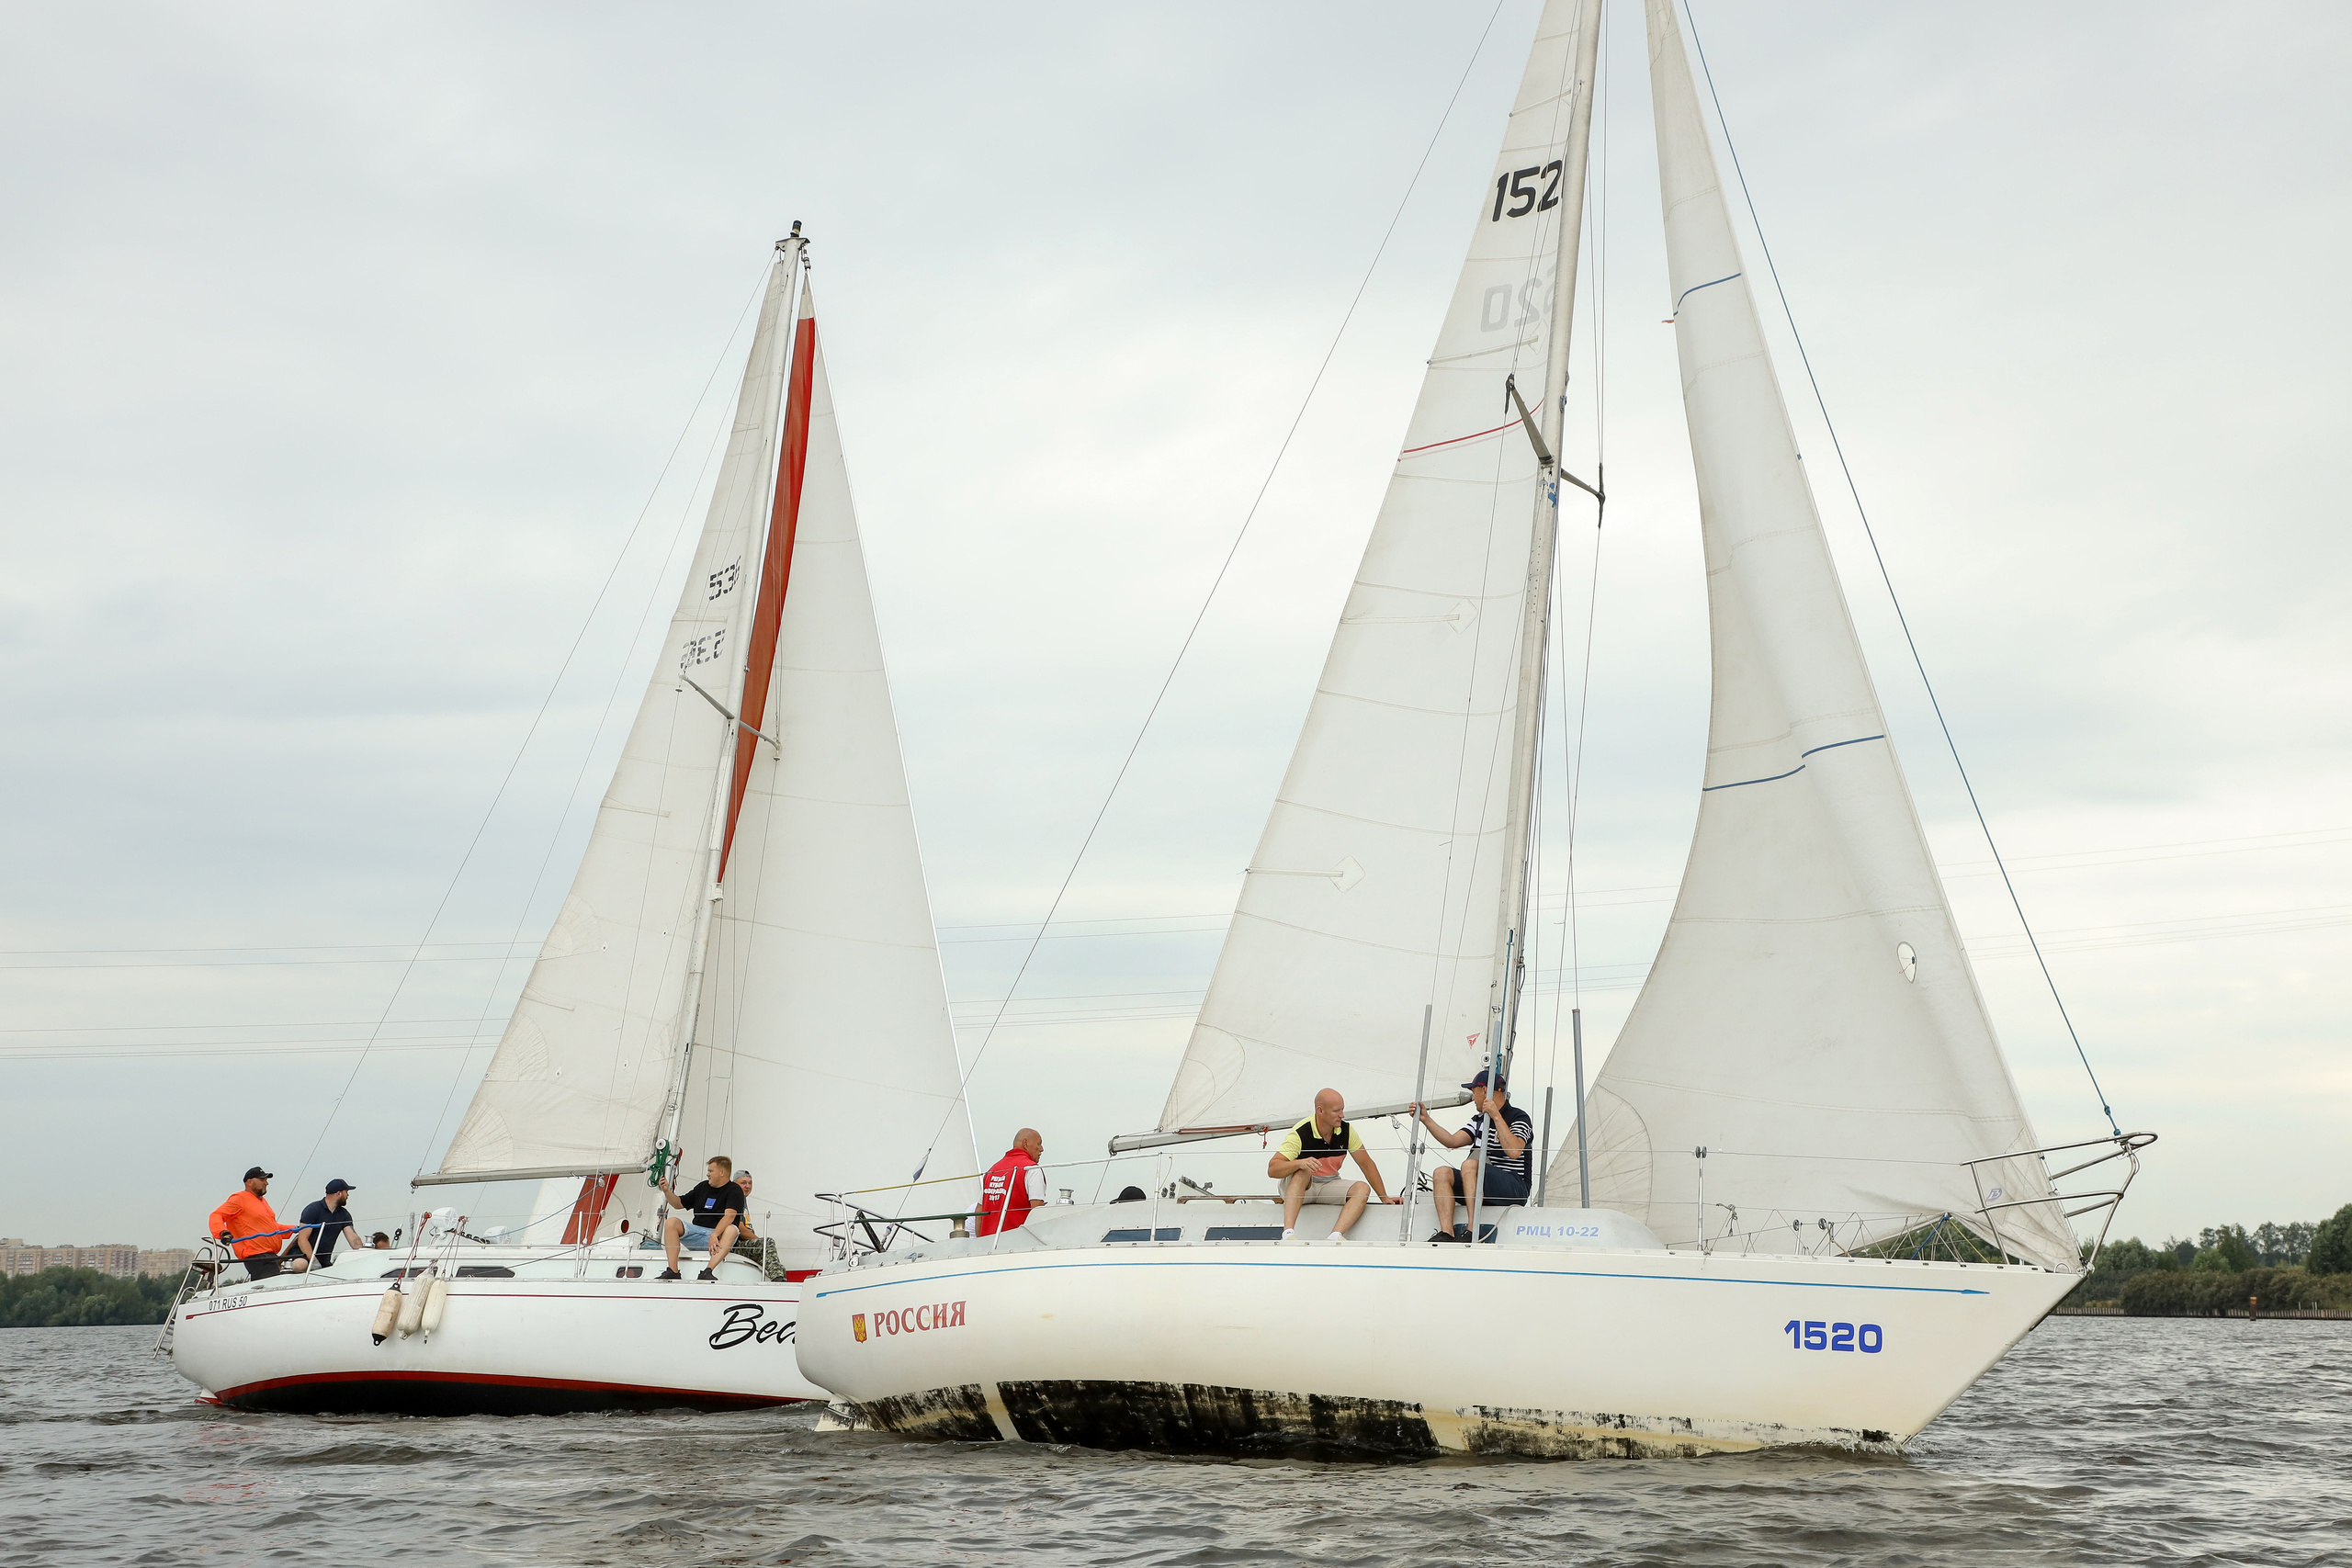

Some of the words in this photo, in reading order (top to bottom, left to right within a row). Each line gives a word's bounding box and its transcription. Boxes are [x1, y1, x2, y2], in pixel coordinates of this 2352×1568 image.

[1492, 156, 1566, 222] 152
[1516, 1225, 1552, 1238] РМЦ
[1556, 1226, 1600, 1237] 10-22
[209, 1300, 220, 1312] 071
[221, 1297, 238, 1310] RUS
[238, 1295, 248, 1307] 50
[873, 1300, 967, 1337] РОССИЯ
[1783, 1319, 1883, 1354] 1520
